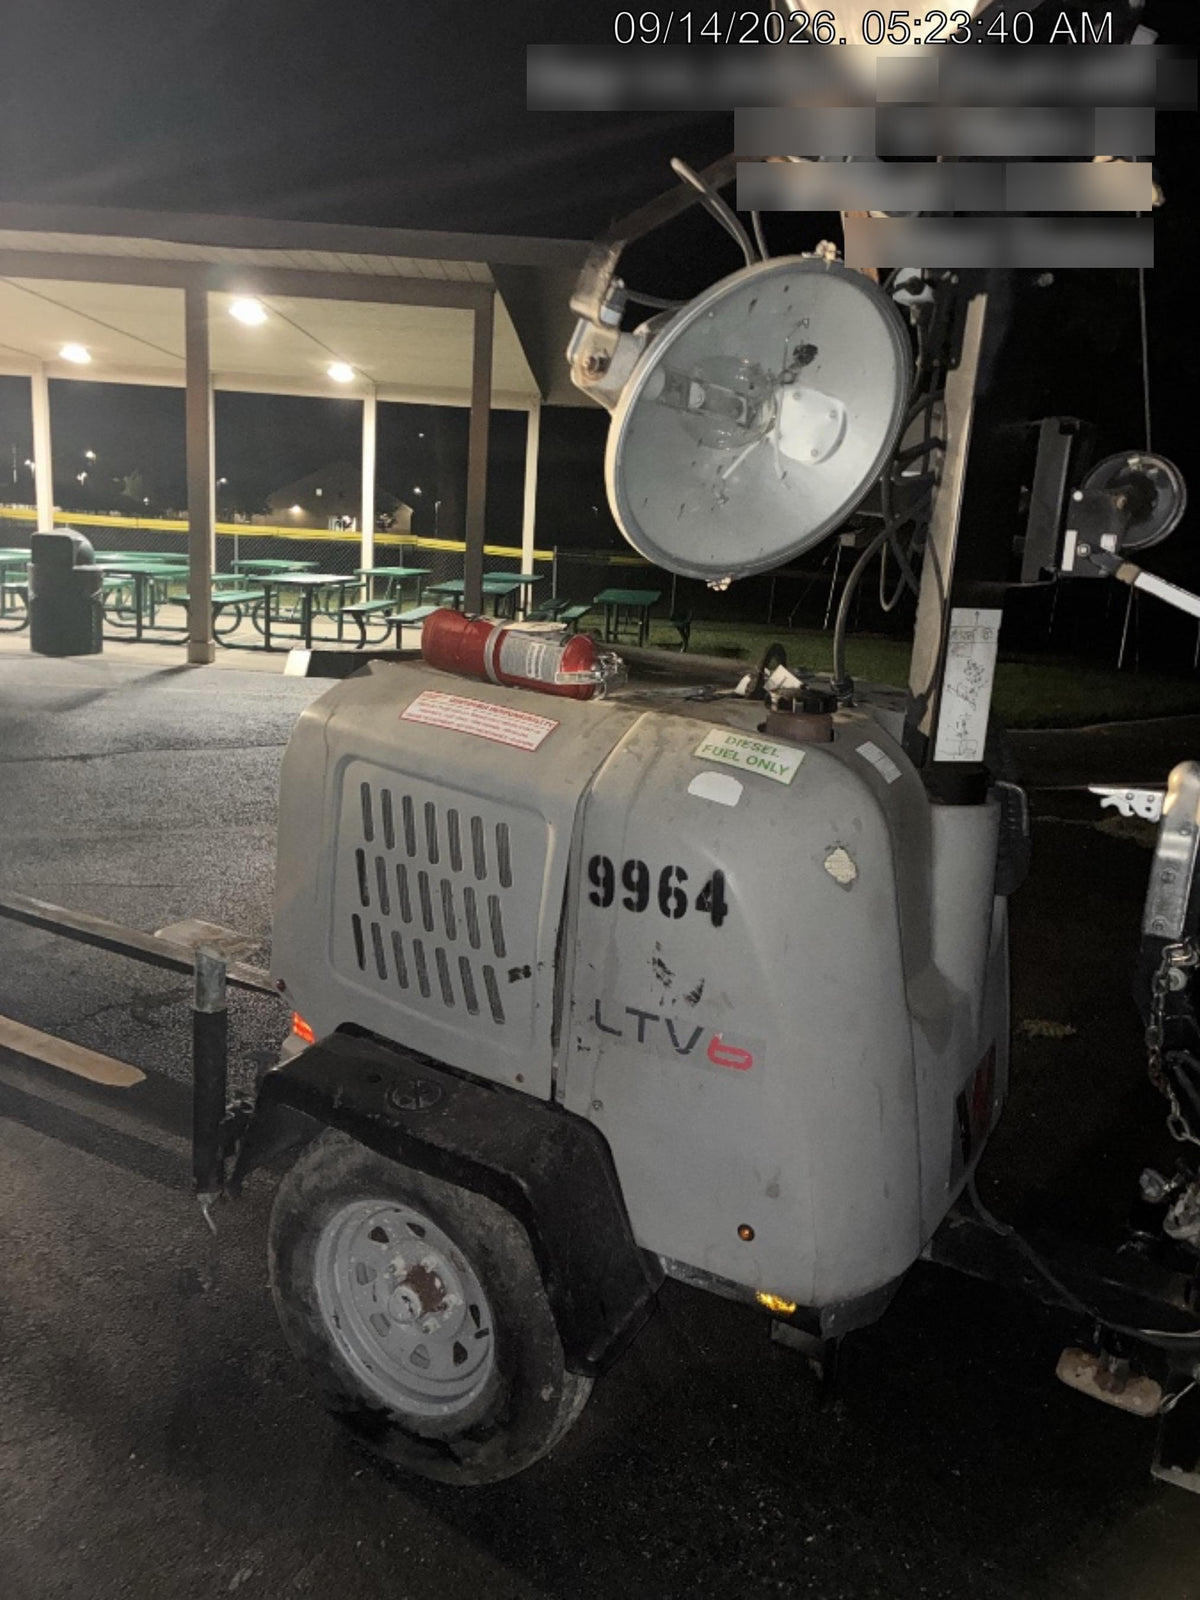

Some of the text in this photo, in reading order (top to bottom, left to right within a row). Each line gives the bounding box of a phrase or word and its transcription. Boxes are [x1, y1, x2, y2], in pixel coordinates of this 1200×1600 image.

[702, 744, 790, 776] FUEL ONLY
[724, 735, 780, 758] DIESEL
[588, 854, 729, 928] 9964
